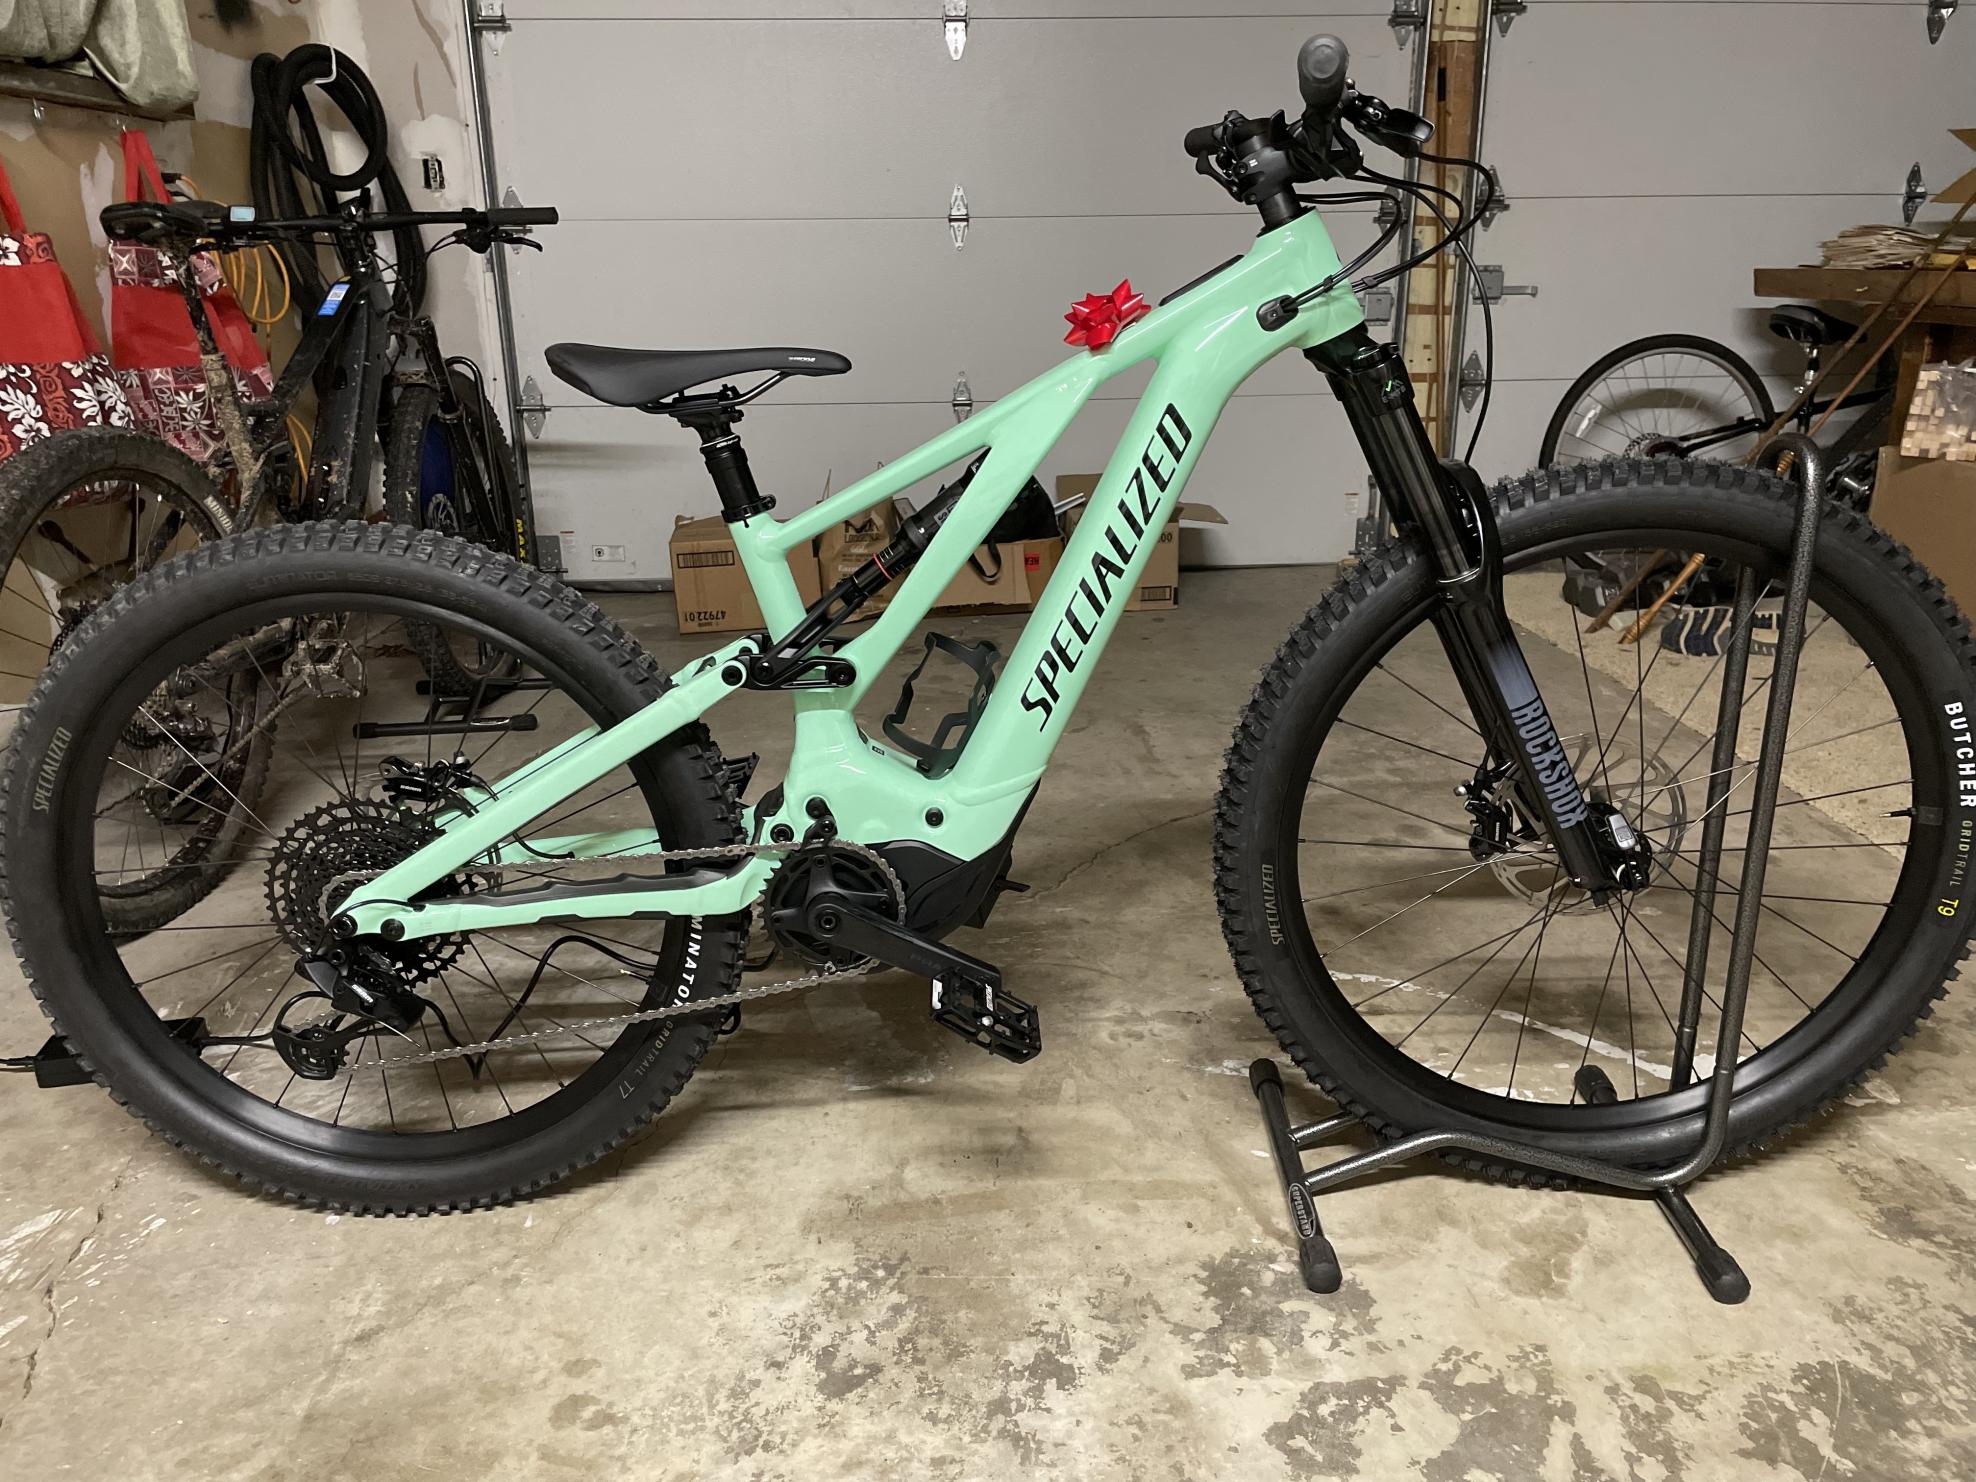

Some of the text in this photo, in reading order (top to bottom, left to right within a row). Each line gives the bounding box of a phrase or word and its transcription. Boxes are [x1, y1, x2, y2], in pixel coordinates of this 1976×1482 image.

[1021, 402, 1192, 732] SPECIALIZED
[32, 726, 72, 814] SPECIALIZED
[1511, 697, 1588, 829] ROCKSHOX
[1944, 702, 1976, 807] BUTCHER
[1262, 864, 1285, 945] SPECIALIZED
[1937, 898, 1959, 917] T9
[673, 916, 703, 1008] MINATOR
[619, 1081, 635, 1099] T7
